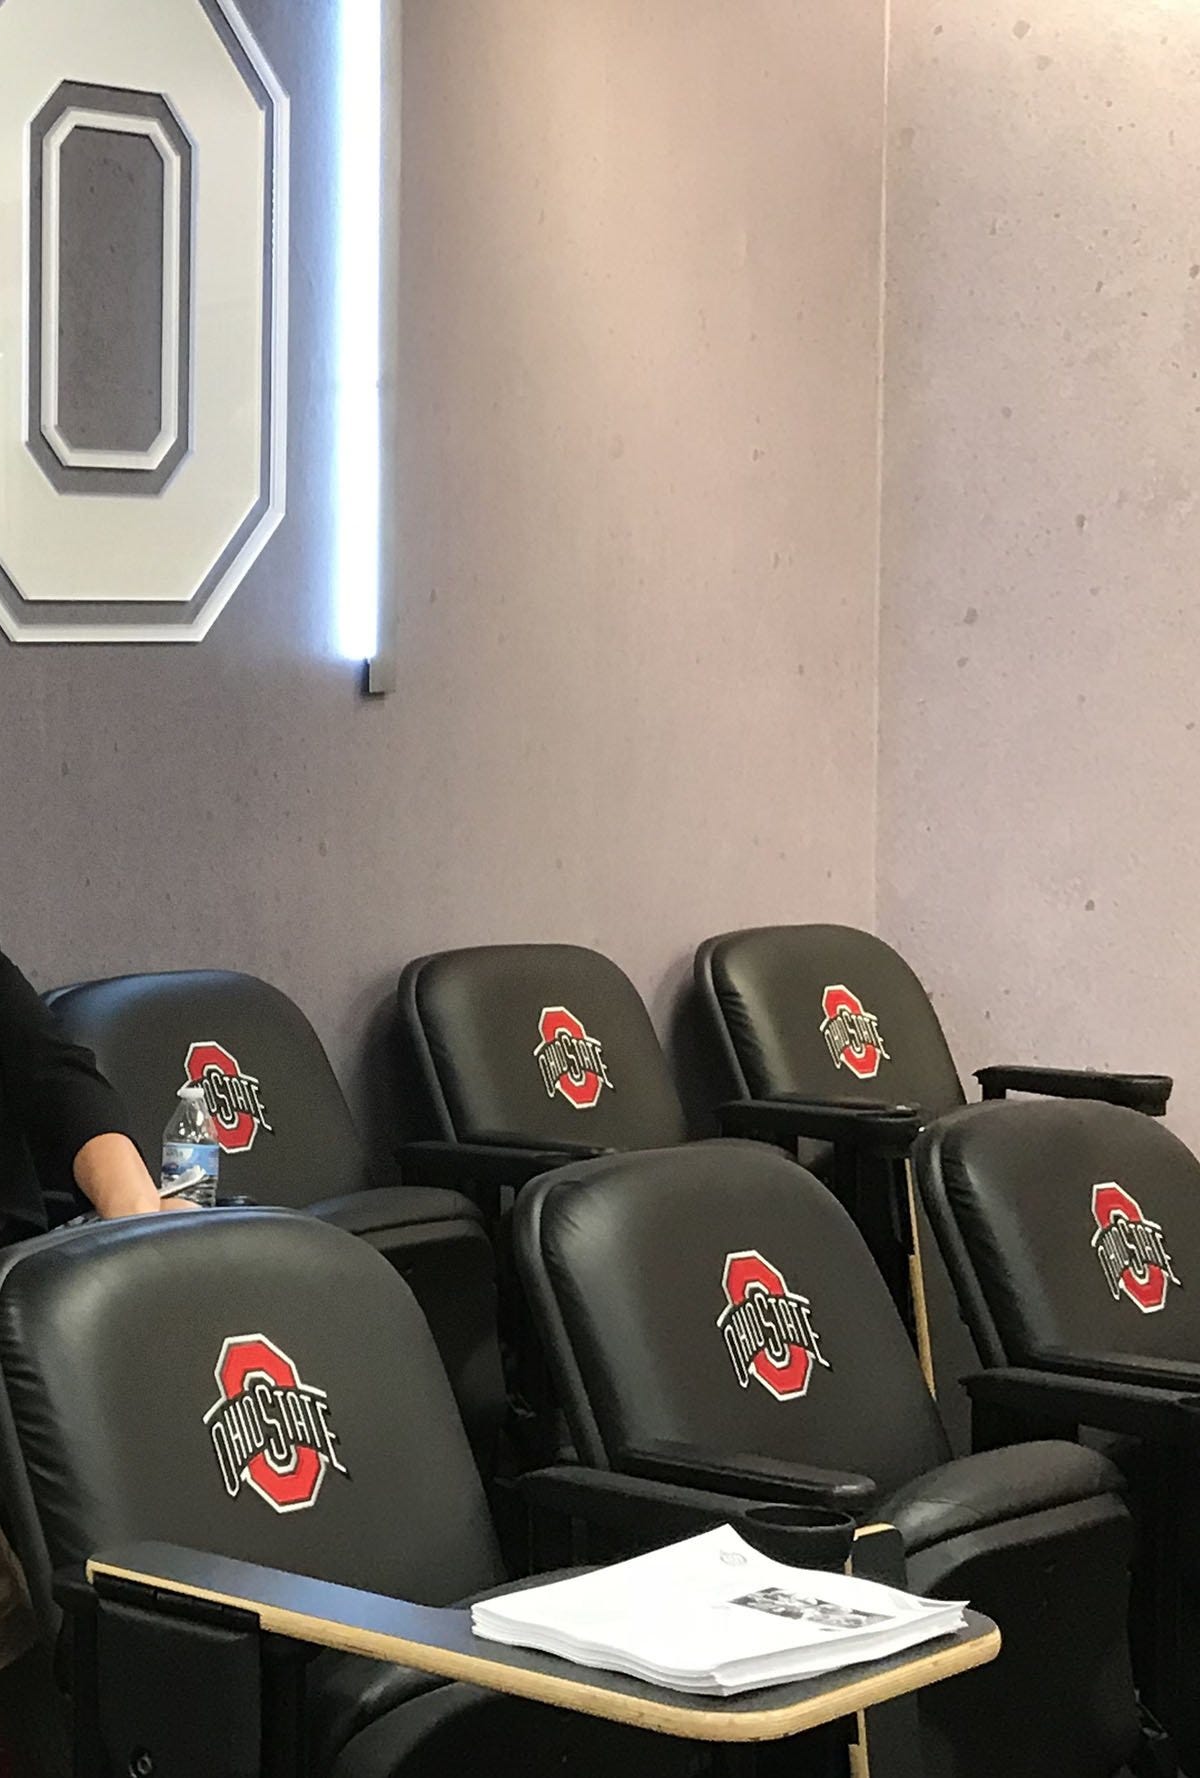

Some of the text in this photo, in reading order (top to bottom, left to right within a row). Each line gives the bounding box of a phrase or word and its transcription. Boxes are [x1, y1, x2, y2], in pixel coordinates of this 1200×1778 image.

[211, 1072, 273, 1131] STATE
[724, 1293, 830, 1388] OHIO STATE
[212, 1385, 347, 1497] OHIO STATE
